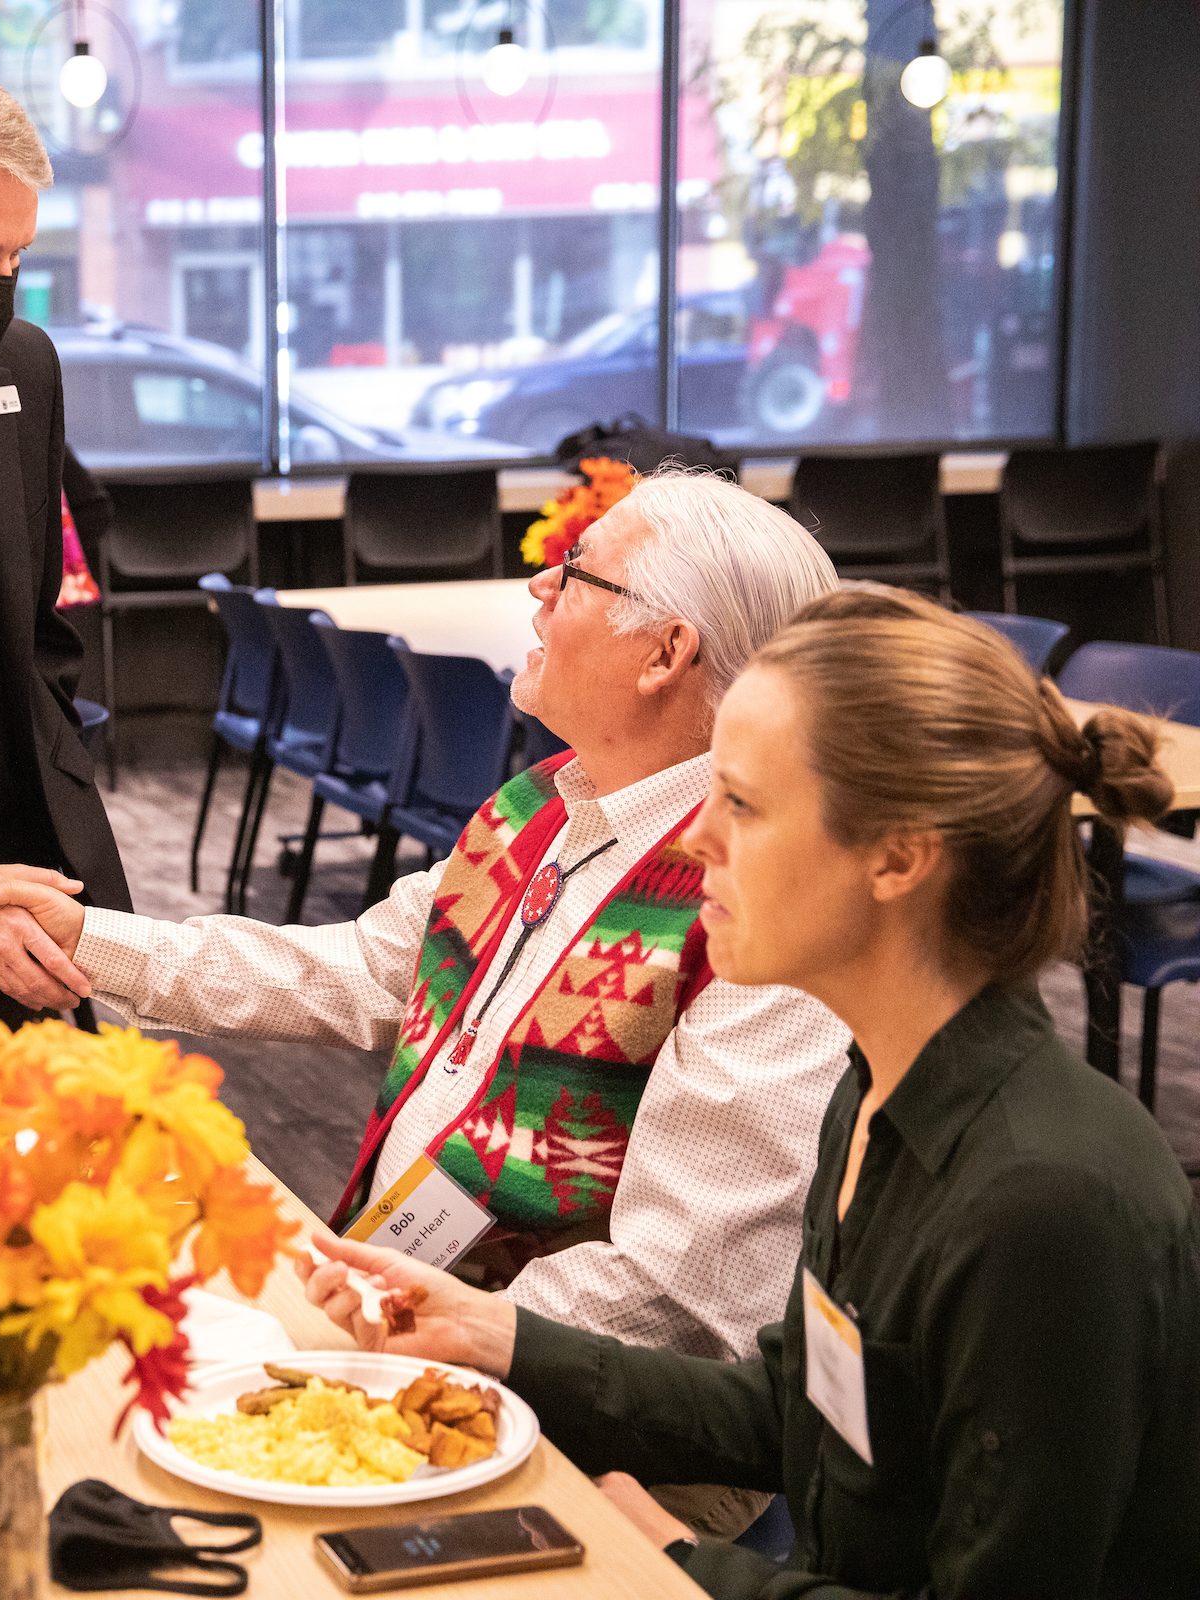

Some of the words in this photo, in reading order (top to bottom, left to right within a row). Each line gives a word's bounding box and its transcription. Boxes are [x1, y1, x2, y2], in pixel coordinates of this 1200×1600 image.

[389, 1212, 415, 1236] Bob
[418, 1208, 451, 1239] Heart
[446, 1239, 460, 1254] 150
